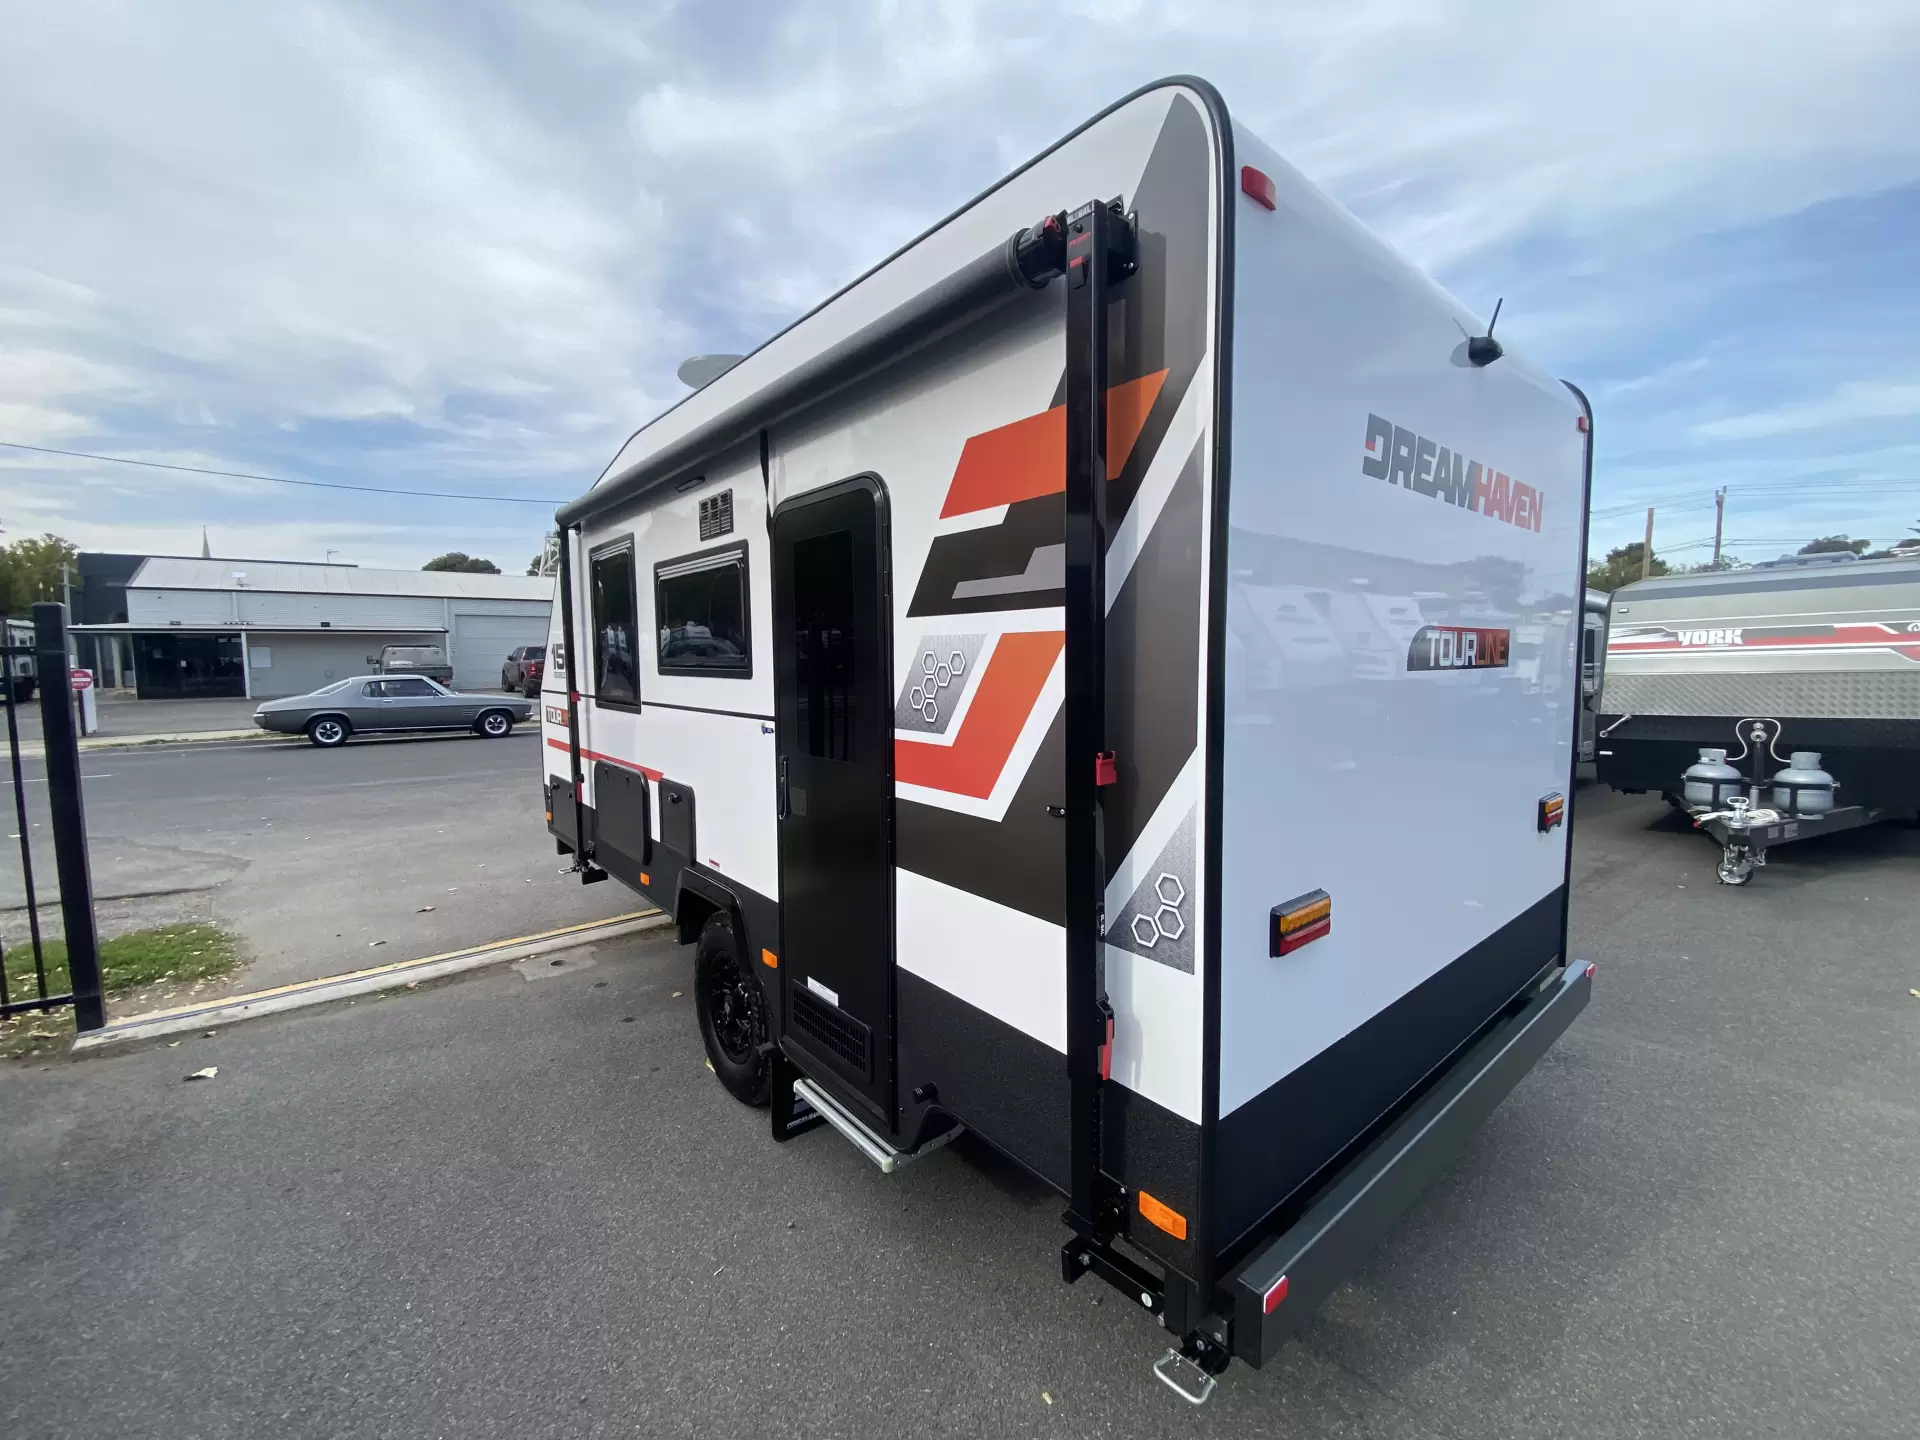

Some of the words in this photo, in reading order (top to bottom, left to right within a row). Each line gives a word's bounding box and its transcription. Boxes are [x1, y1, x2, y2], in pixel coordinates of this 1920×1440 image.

[1362, 412, 1544, 533] DREAMHAVEN
[1426, 629, 1508, 667] TOURLINE
[1677, 628, 1743, 647] YORK
[551, 643, 565, 670] 15
